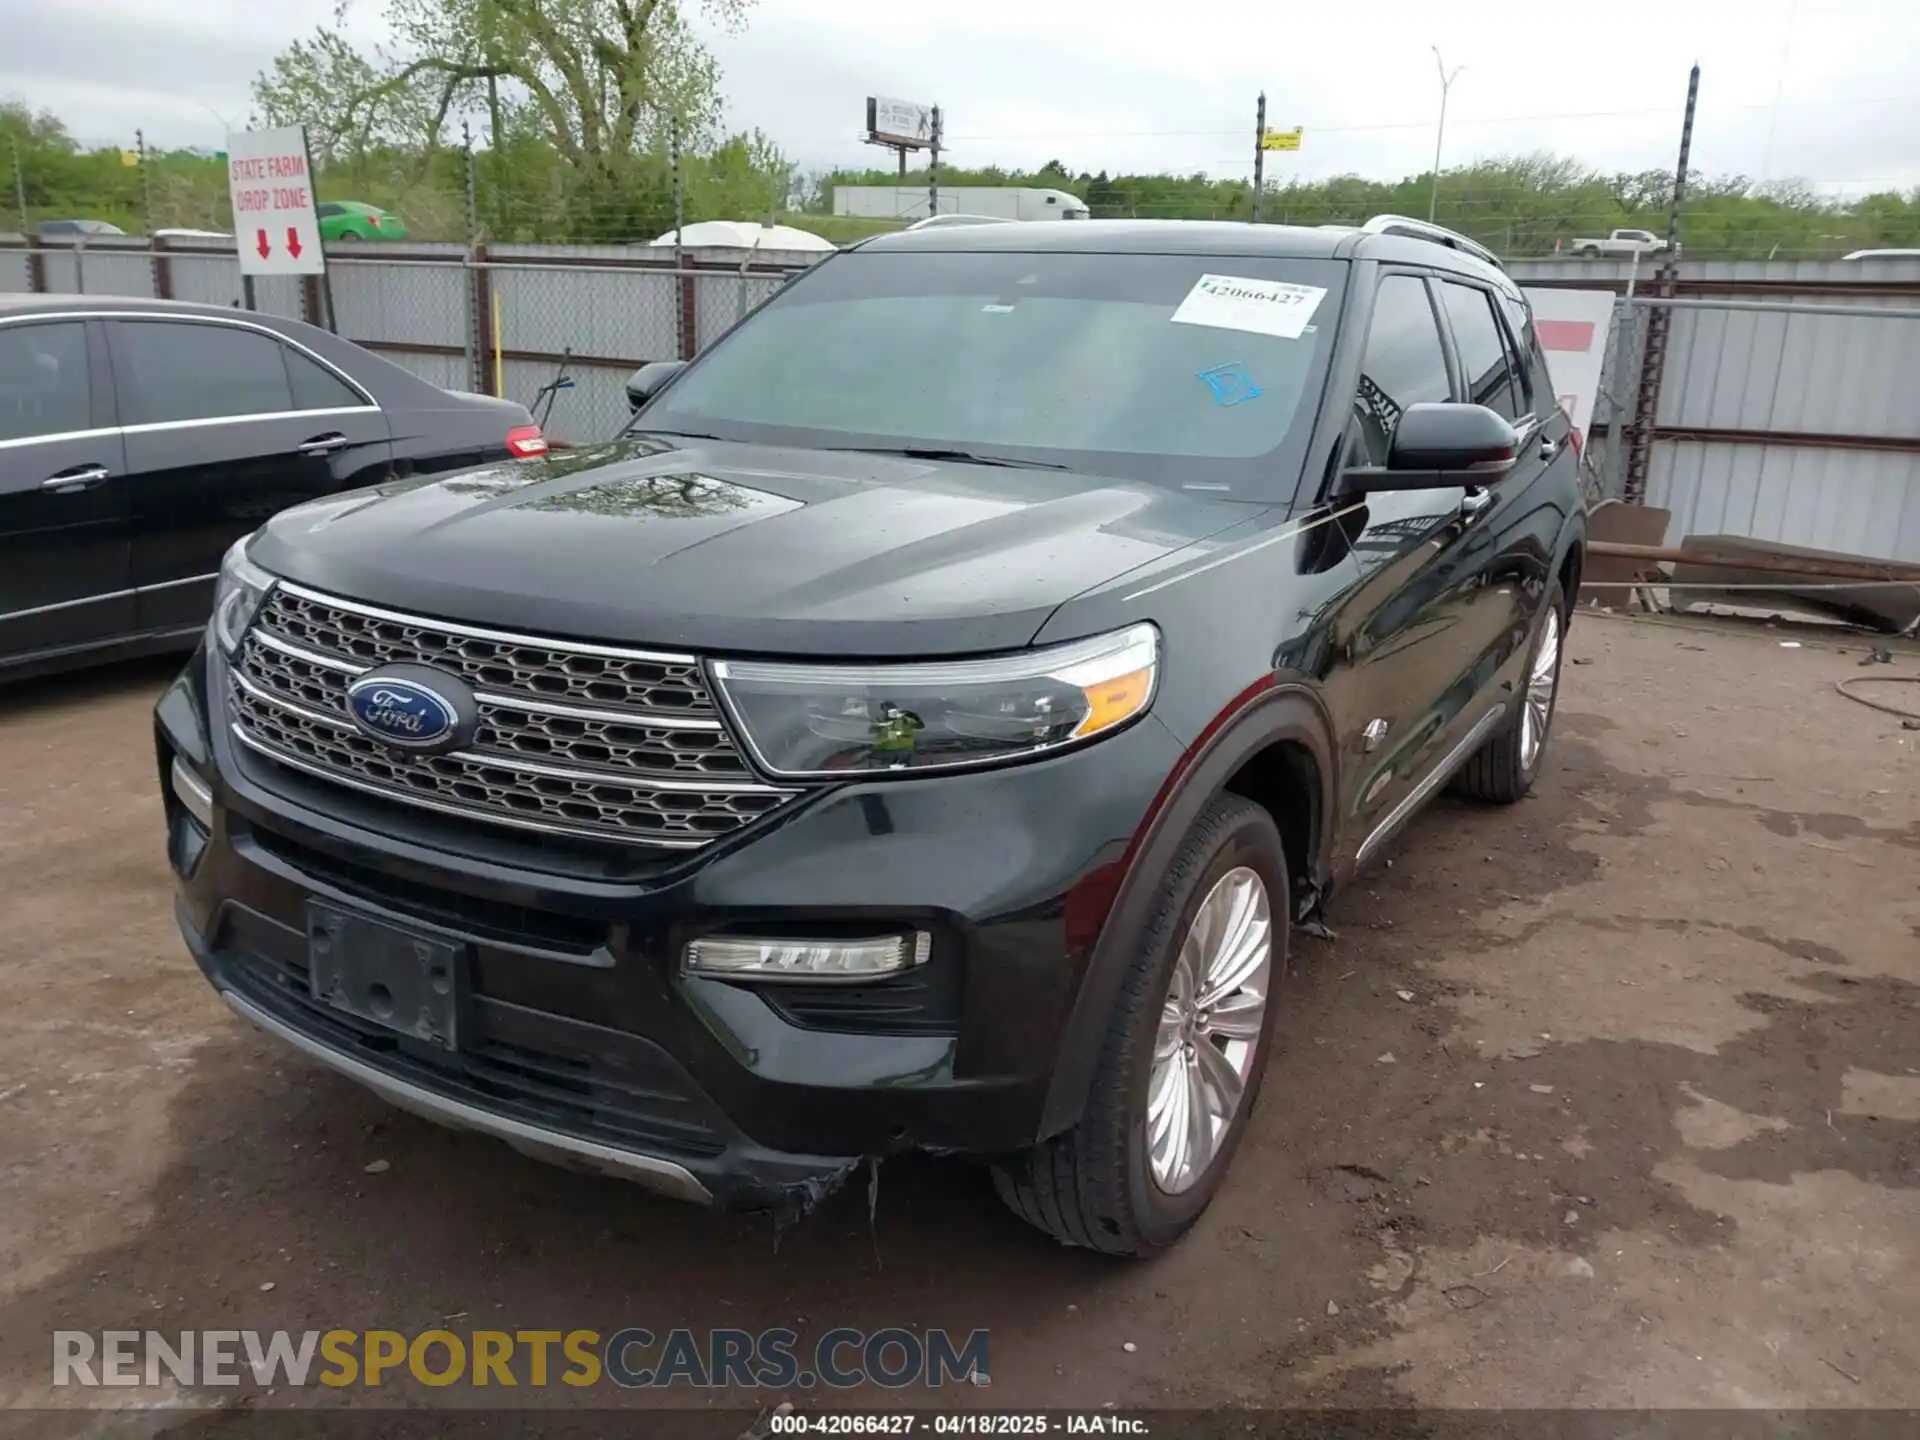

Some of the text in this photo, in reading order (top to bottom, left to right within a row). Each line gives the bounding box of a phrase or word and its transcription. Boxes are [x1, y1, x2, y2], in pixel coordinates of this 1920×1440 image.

[231, 155, 304, 181] STATE FARM
[237, 187, 309, 212] DROP ZONE
[365, 689, 427, 732] Ford
